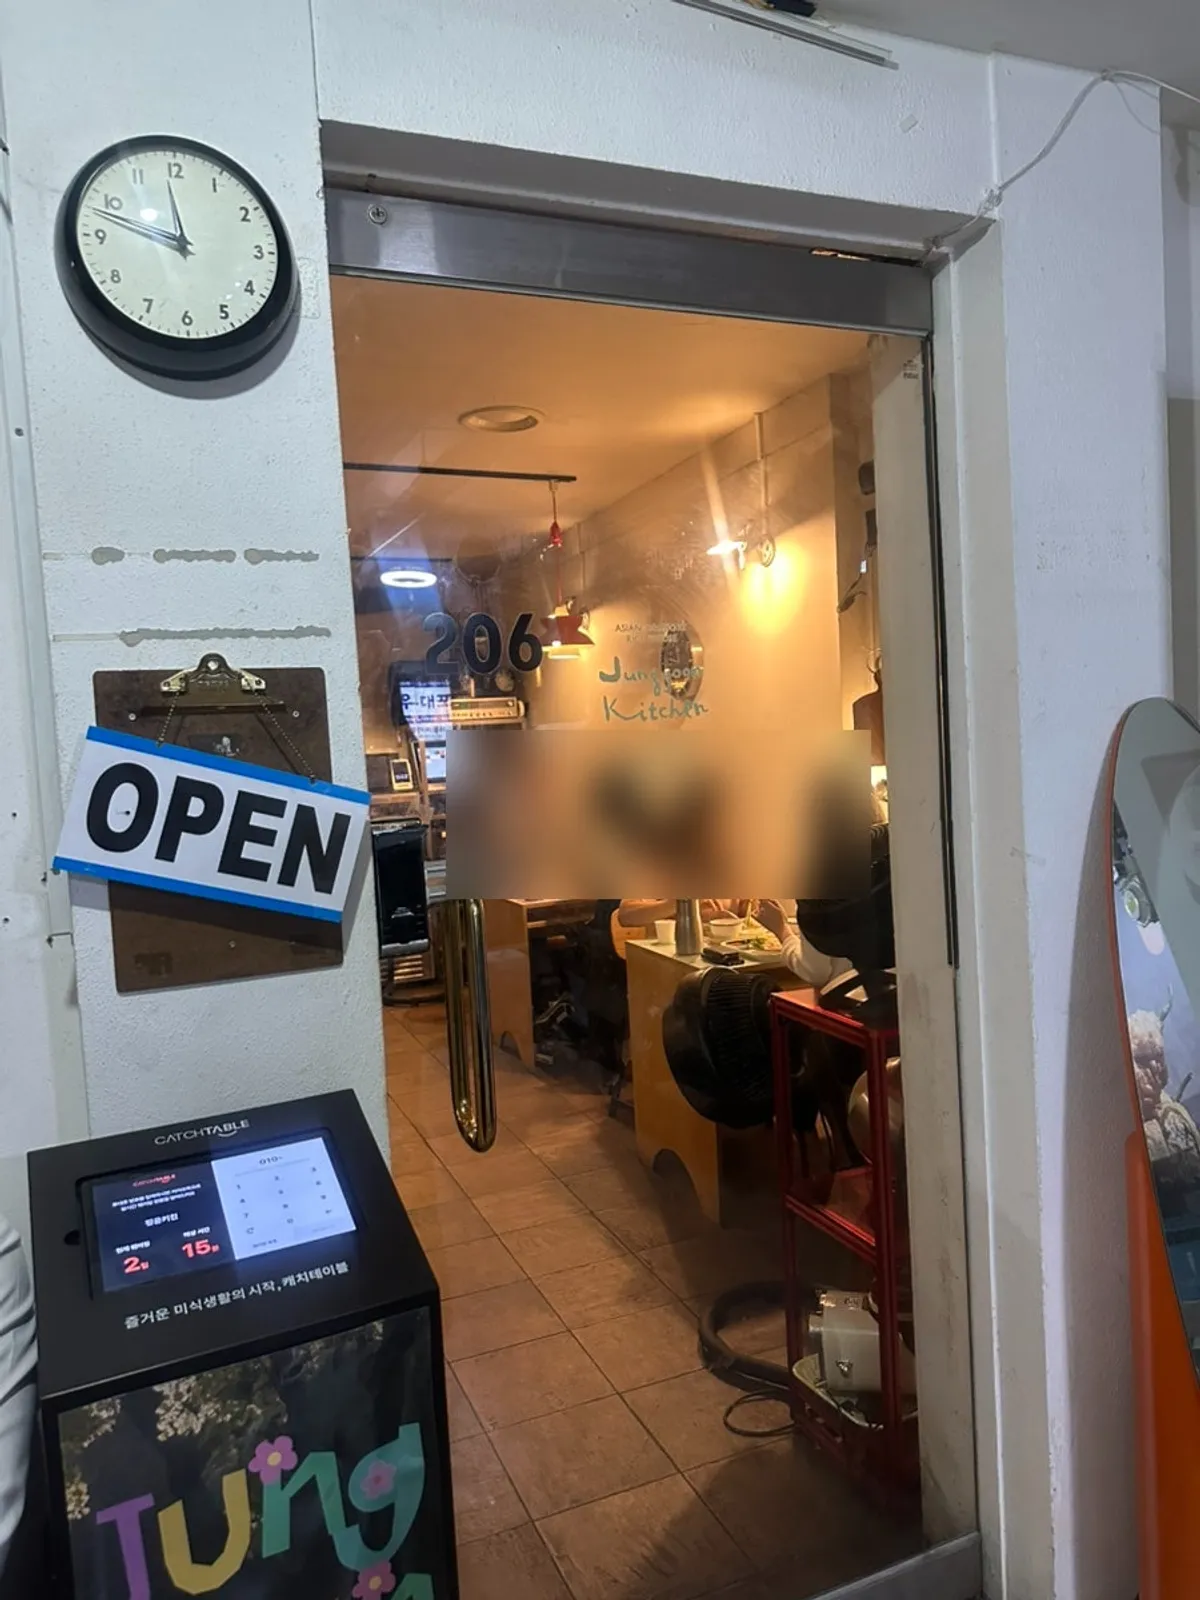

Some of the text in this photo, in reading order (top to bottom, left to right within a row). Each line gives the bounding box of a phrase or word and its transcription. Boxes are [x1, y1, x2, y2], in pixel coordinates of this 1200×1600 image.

[132, 168, 144, 185] 11
[167, 162, 185, 179] 12
[211, 177, 218, 193] 1
[104, 193, 123, 210] 10
[239, 206, 251, 223] 2
[95, 229, 107, 244] 9
[253, 245, 264, 260] 3
[110, 269, 121, 284] 8
[243, 280, 255, 296] 4
[143, 298, 154, 314] 7
[219, 304, 230, 320] 5
[181, 311, 193, 326] 6
[423, 612, 543, 677] 206
[603, 695, 709, 722] Kitchen
[86, 762, 351, 895] OPEN
[154, 1118, 250, 1146] CATCHTABLE
[124, 1307, 170, 1330] 즐거운
[174, 1287, 246, 1316] 미식생활의
